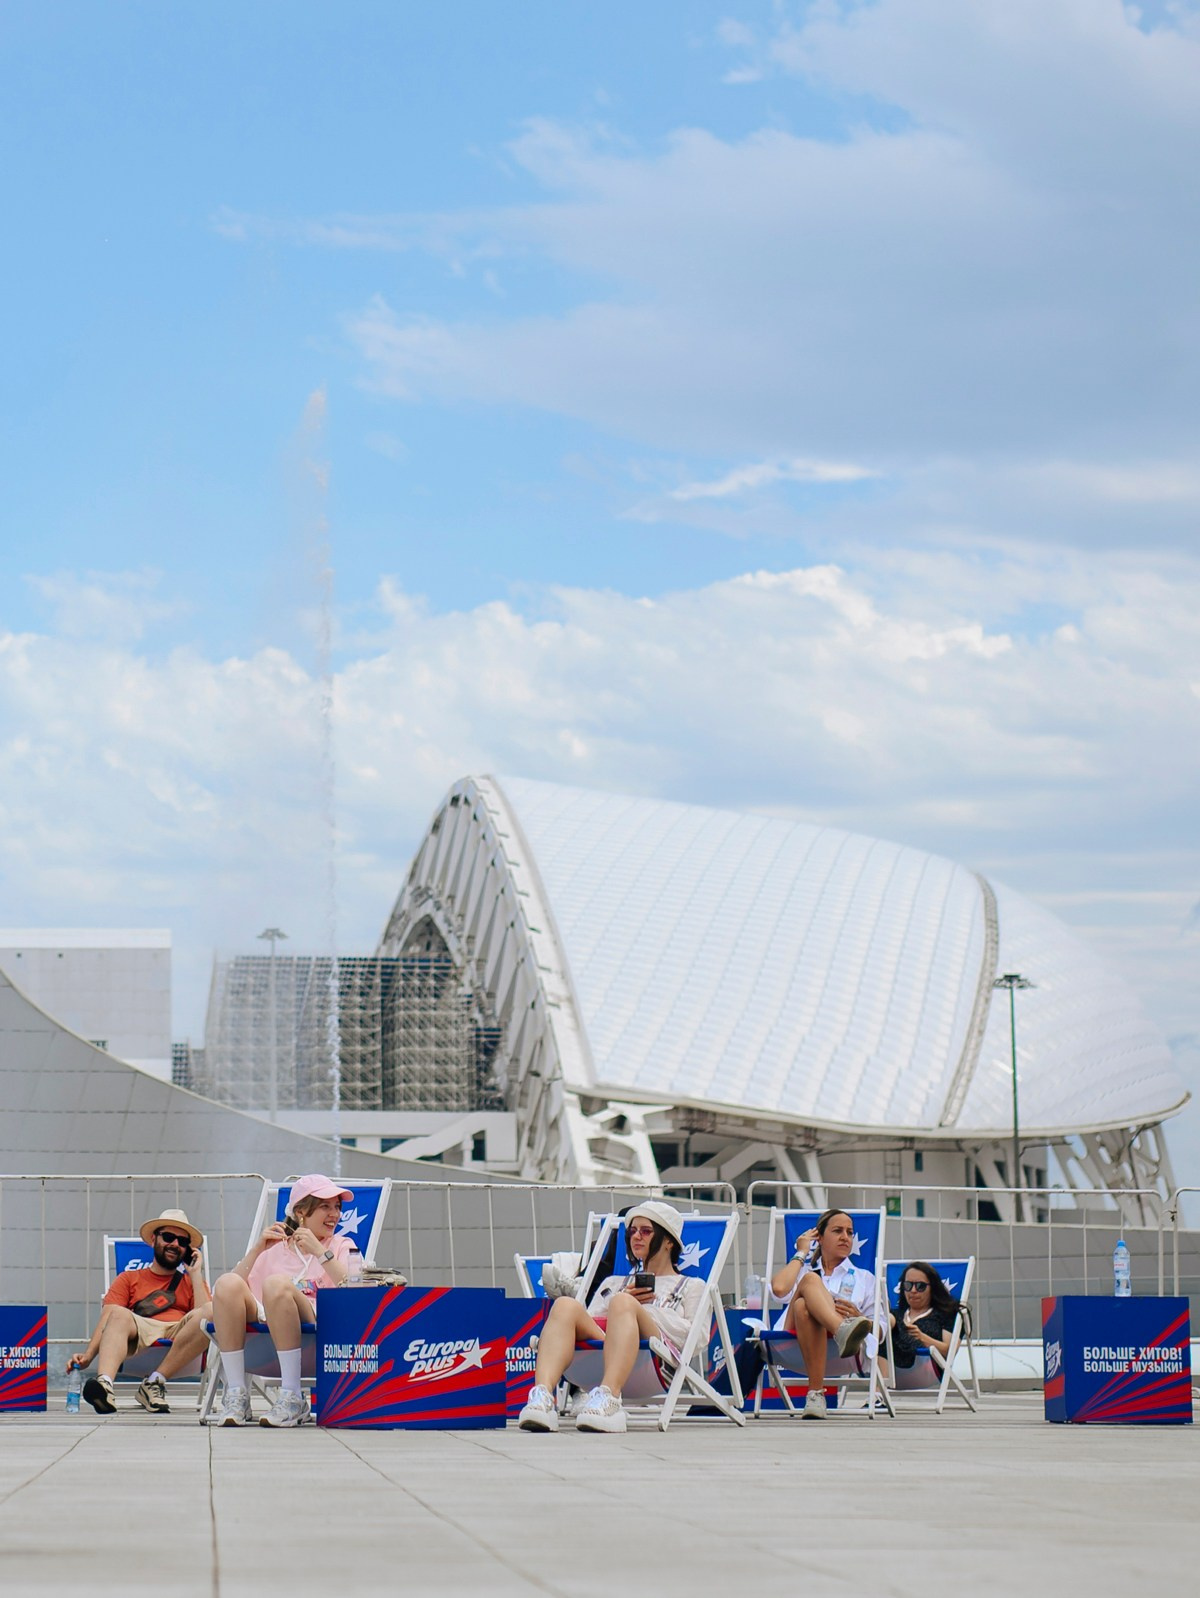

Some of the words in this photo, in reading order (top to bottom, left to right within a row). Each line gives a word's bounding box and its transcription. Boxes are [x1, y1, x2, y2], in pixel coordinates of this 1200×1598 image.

[8, 1346, 41, 1358] ХИТОВ!
[324, 1344, 353, 1359] БОЛЬШЕ
[353, 1344, 379, 1359] ХИТОВ!
[505, 1346, 536, 1360] ИТОВ!
[1083, 1346, 1136, 1360] БОЛЬШЕ
[1138, 1346, 1183, 1361] ХИТОВ!
[3, 1358, 41, 1369] МУЗЫКИ!
[324, 1360, 349, 1373] БОЛЬШЕ
[349, 1360, 379, 1374] МУЗЫКИ!
[505, 1360, 536, 1372] ЗЫКИ!
[1083, 1360, 1130, 1373] БОЛЬШЕ
[1131, 1360, 1183, 1373] МУЗЫКИ!
